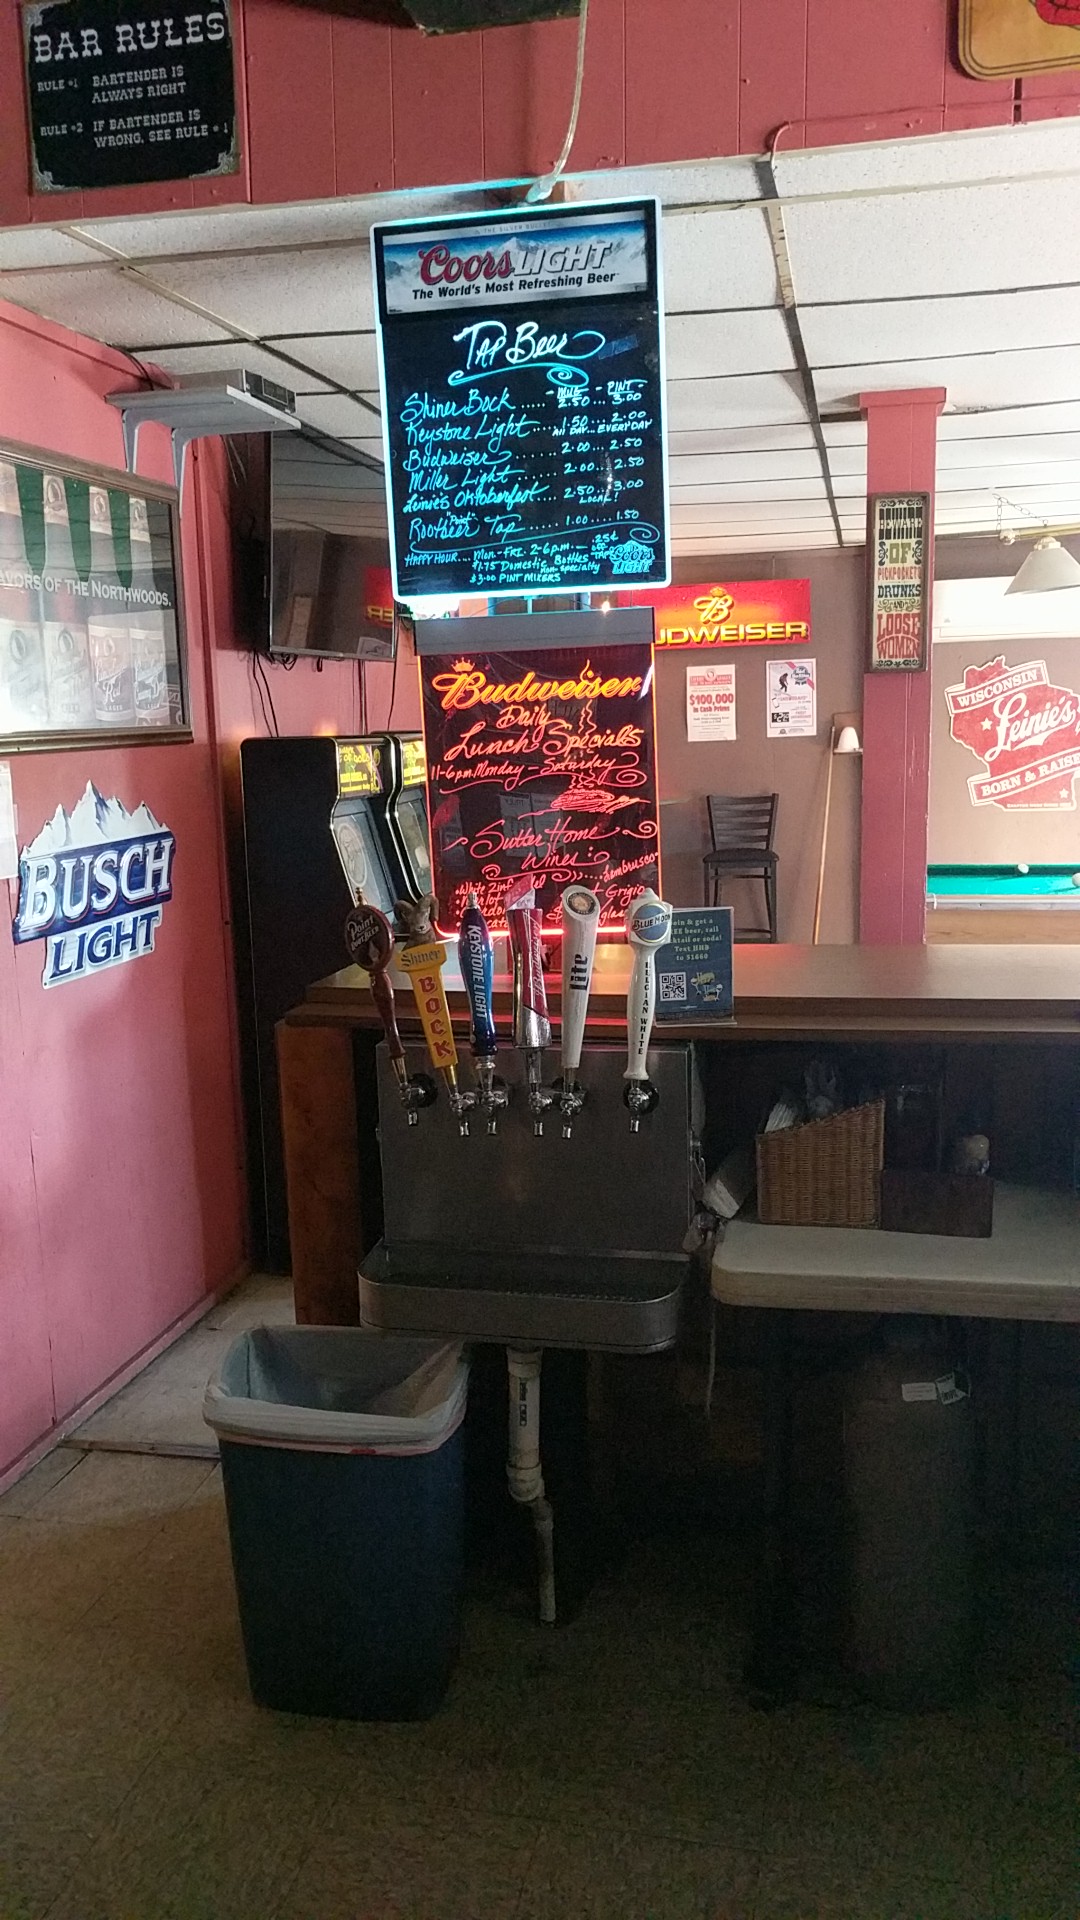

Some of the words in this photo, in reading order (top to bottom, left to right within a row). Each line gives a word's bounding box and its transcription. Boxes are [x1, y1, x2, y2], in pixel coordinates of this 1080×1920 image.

[34, 29, 102, 64] BAR
[116, 12, 225, 53] RULES
[37, 80, 65, 92] RULE
[92, 68, 168, 88] BARTENDER
[172, 65, 184, 78] IS
[92, 87, 144, 104] ALWAYS
[147, 82, 187, 98] RIGHT
[40, 124, 67, 137] RULE
[93, 120, 104, 132] IF
[109, 111, 184, 131] BARTENDER
[188, 109, 201, 121] IS
[149, 130, 173, 143] SEE
[175, 124, 208, 139] RULE
[418, 244, 515, 286] Coors
[513, 241, 613, 277] LIGHT
[412, 288, 433, 300] The
[438, 283, 481, 298] World's
[485, 279, 514, 294] Most
[519, 273, 583, 291] Refreshing
[587, 271, 617, 285] Beer
[505, 321, 590, 365] Beer
[607, 379, 647, 396] PINT
[400, 391, 466, 422] Shiner
[463, 387, 516, 416] Bock
[612, 393, 642, 405] 3.00
[405, 419, 472, 456] Keystone
[474, 413, 541, 453] Light
[562, 415, 589, 432] 1.50
[611, 411, 646, 422] 2.00
[402, 448, 512, 471] Budweiser
[561, 441, 590, 453] 2.00
[609, 437, 643, 450] 2.50
[408, 467, 458, 493] Miller
[461, 464, 526, 491] Light
[564, 462, 595, 474] 2.00
[614, 456, 645, 469] 2.50
[564, 485, 595, 498] 2.50
[613, 479, 644, 491] 3.00
[566, 515, 588, 526] 1.00
[616, 509, 640, 521] 1.50
[879, 506, 923, 541] BEWARE
[554, 552, 589, 565] Bottles
[889, 542, 911, 564] OF
[45, 576, 62, 592] OF
[64, 579, 90, 597] THE
[499, 573, 524, 583] PINT
[877, 584, 921, 598] DRUNKS
[877, 613, 920, 640] LOOSE
[877, 637, 920, 660] WOMEN
[432, 671, 641, 710] Budweiser
[689, 692, 734, 706] $100,000
[957, 669, 1038, 708] WISCONSIN
[496, 704, 558, 742] Daily
[443, 721, 539, 761] Lunch
[981, 774, 1022, 797] BORN
[1025, 769, 1037, 782] &
[470, 818, 546, 859] Sutter
[544, 816, 612, 851] Home
[20, 838, 173, 932] BUSCH
[632, 919, 654, 931] BLUE
[654, 913, 671, 925] MOON
[49, 911, 160, 979] LIGHT
[400, 947, 440, 968] Shiner
[467, 924, 485, 982] KEYSTONE
[472, 982, 488, 1019] LIGHT
[418, 976, 454, 1060] BOCK
[637, 1017, 649, 1056] WHITE
